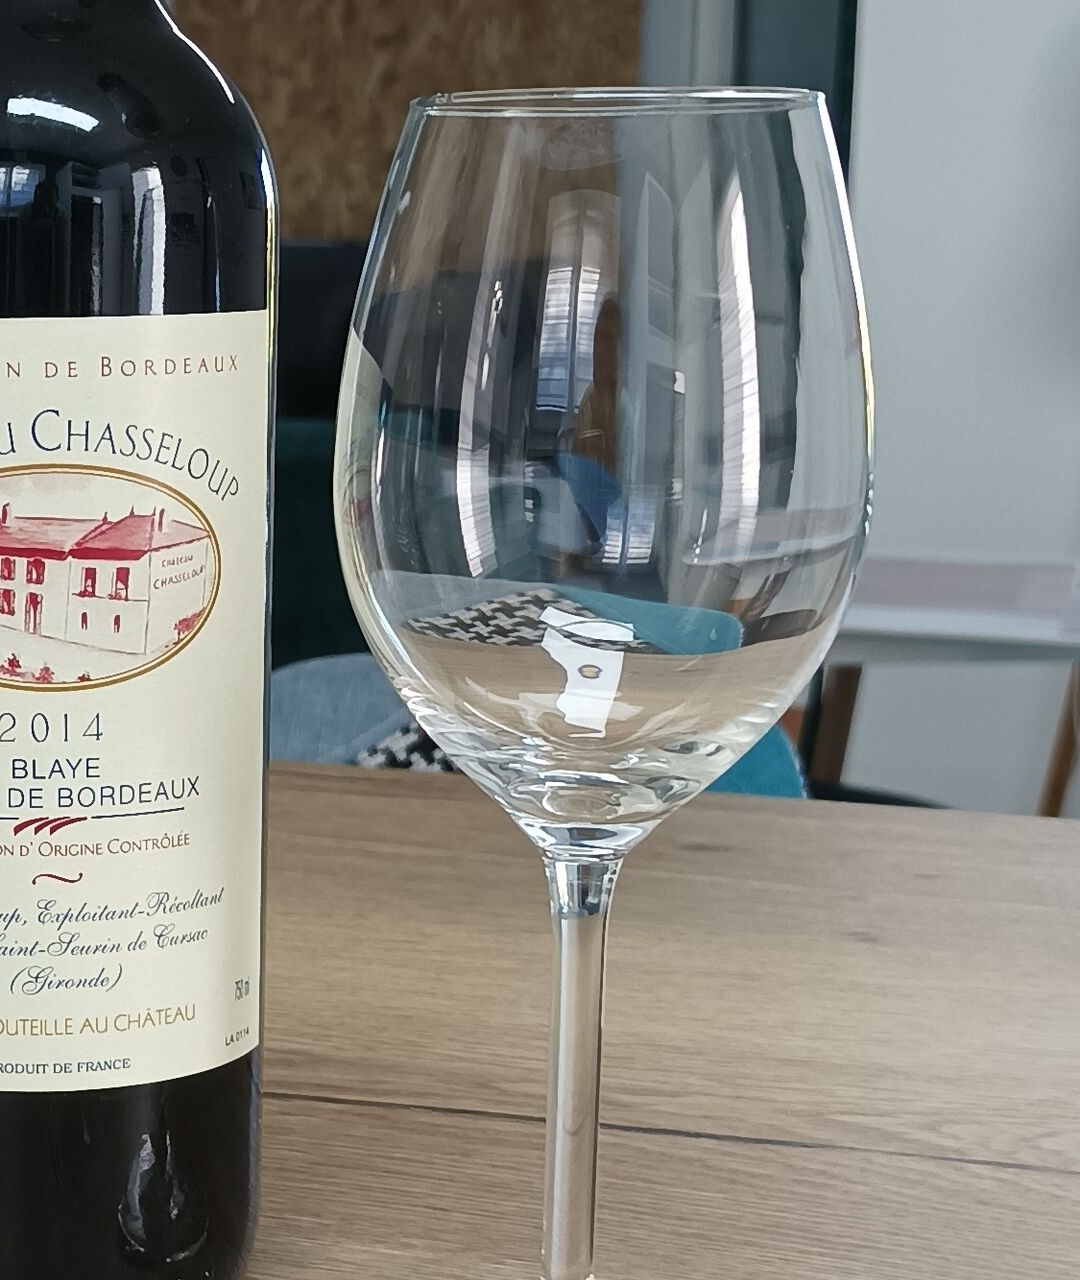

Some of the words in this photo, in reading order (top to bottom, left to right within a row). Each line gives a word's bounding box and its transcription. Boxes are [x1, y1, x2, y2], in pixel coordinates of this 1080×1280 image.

[44, 361, 79, 379] DE
[100, 353, 240, 378] BORDEAUX
[31, 408, 240, 502] CHASSELOUP
[11, 757, 101, 780] BLAYE
[7, 787, 44, 809] DE
[57, 775, 200, 809] BORDEAUX
[38, 841, 103, 857] ORIGINE
[107, 829, 191, 854] CONTRÔLÉE
[36, 886, 225, 932] Exploitant-Récoltant
[127, 930, 148, 953] de
[153, 923, 209, 949] Cursac
[10, 963, 123, 996] (Gironde)
[79, 1016, 109, 1035] AU
[113, 1003, 197, 1033] CHÂTEAU
[52, 1061, 74, 1074] DE
[77, 1057, 132, 1073] FRANCE
